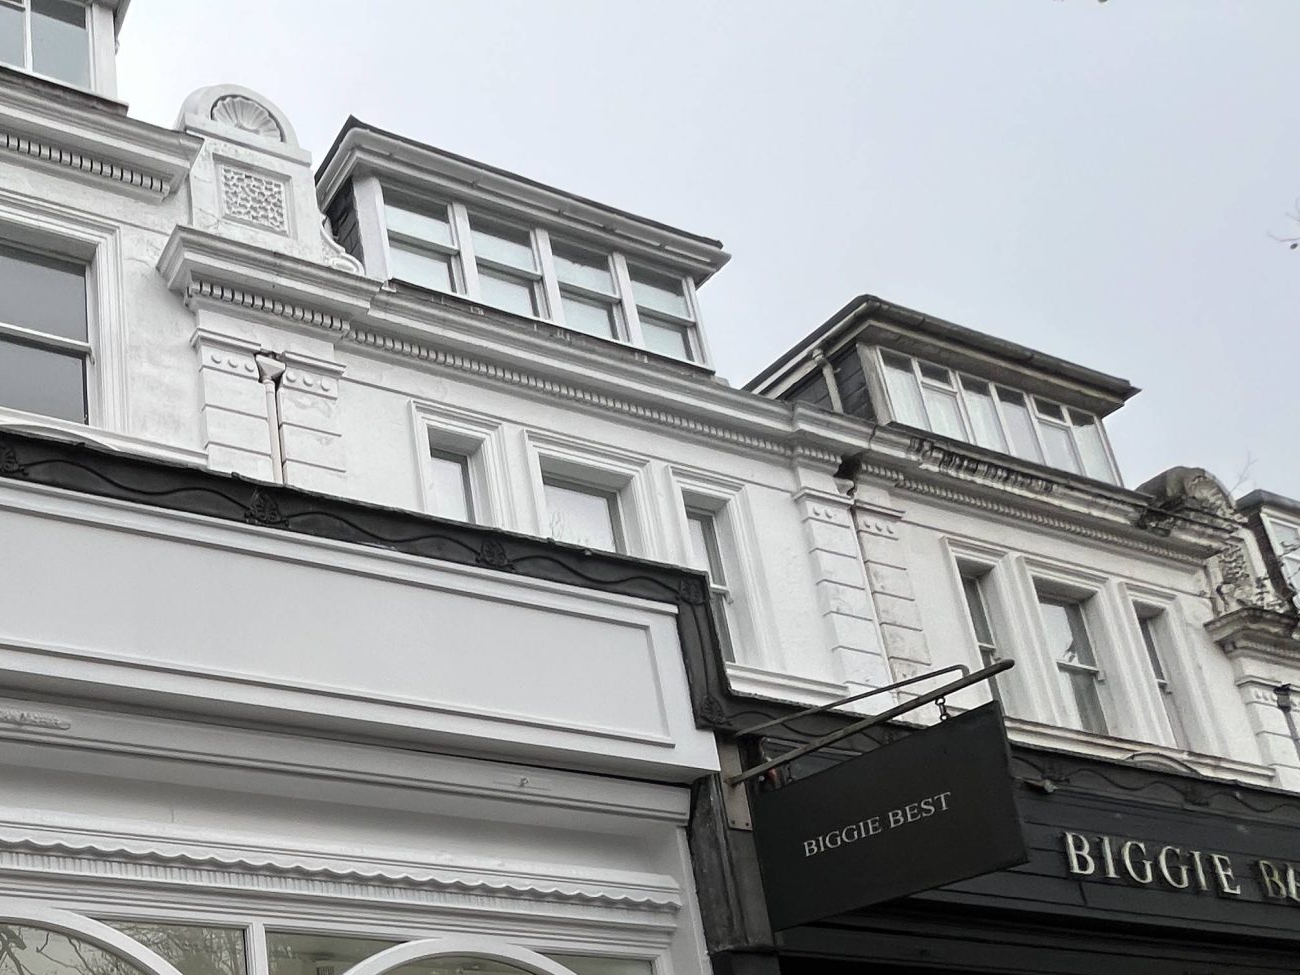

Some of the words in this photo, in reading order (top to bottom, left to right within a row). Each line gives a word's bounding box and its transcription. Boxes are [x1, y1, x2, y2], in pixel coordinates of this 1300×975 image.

[803, 816, 882, 857] BIGGIE
[888, 791, 951, 829] BEST
[1062, 830, 1241, 896] BIGGIE
